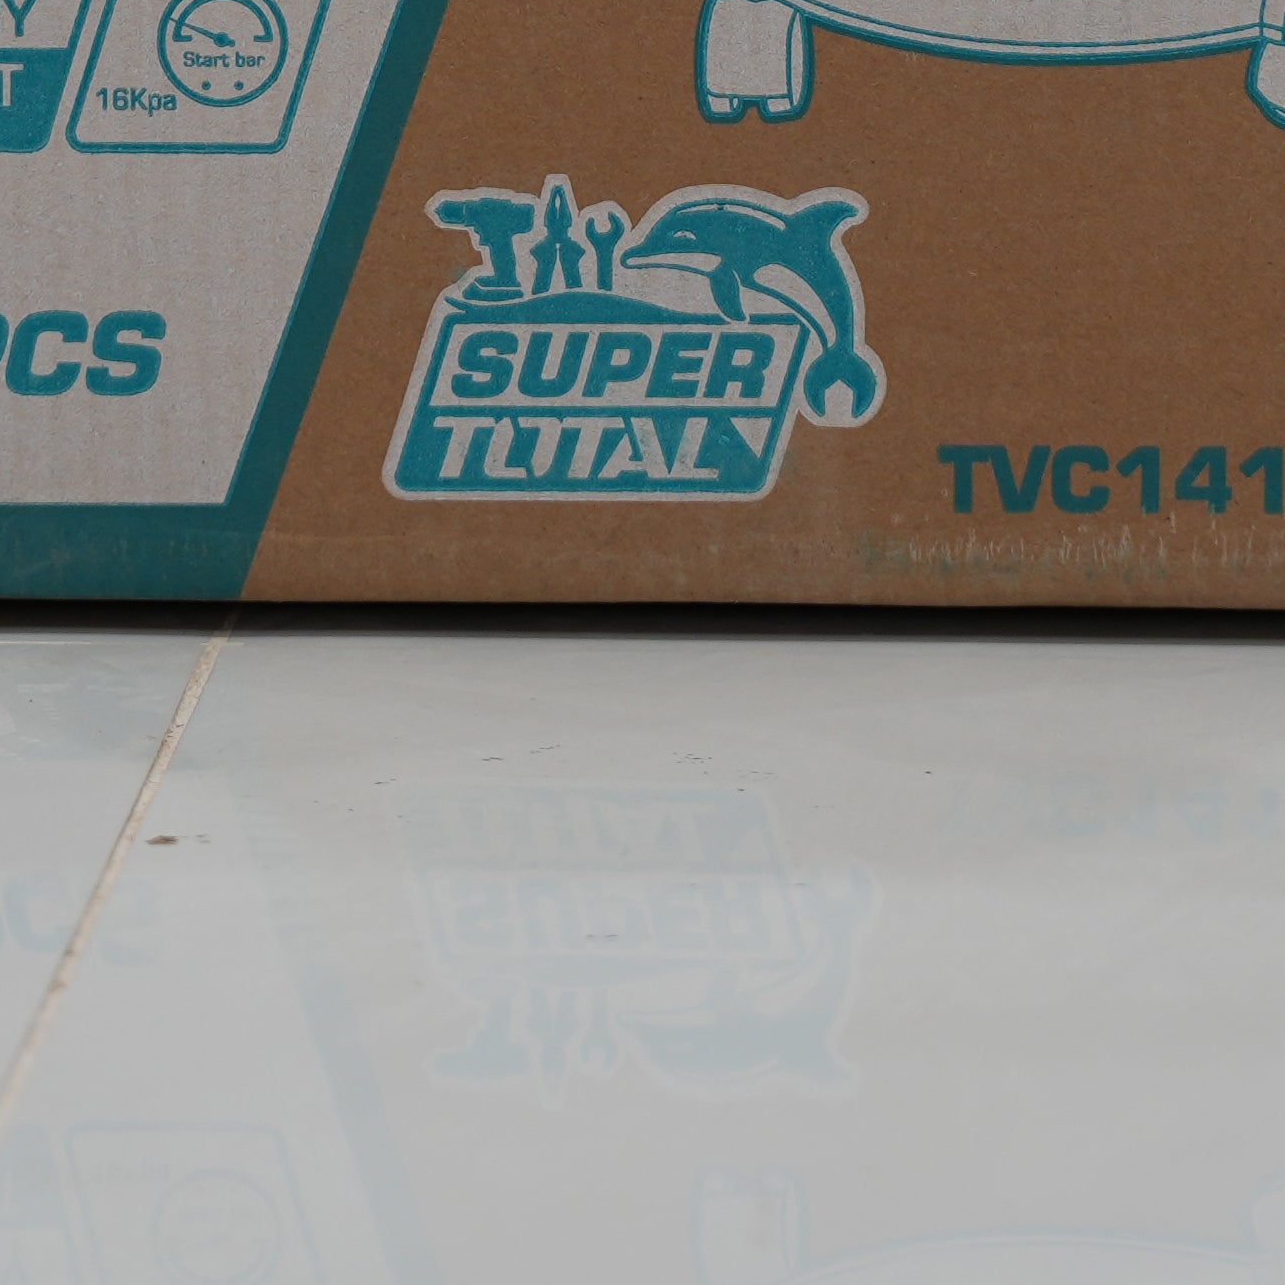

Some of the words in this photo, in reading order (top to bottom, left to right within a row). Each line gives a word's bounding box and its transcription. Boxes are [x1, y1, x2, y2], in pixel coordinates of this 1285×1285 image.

[182, 49, 230, 69] Start
[234, 49, 267, 69] bar
[96, 85, 179, 118] 16Kpa
[451, 328, 777, 400] SUPER
[432, 415, 719, 480] TOTAL
